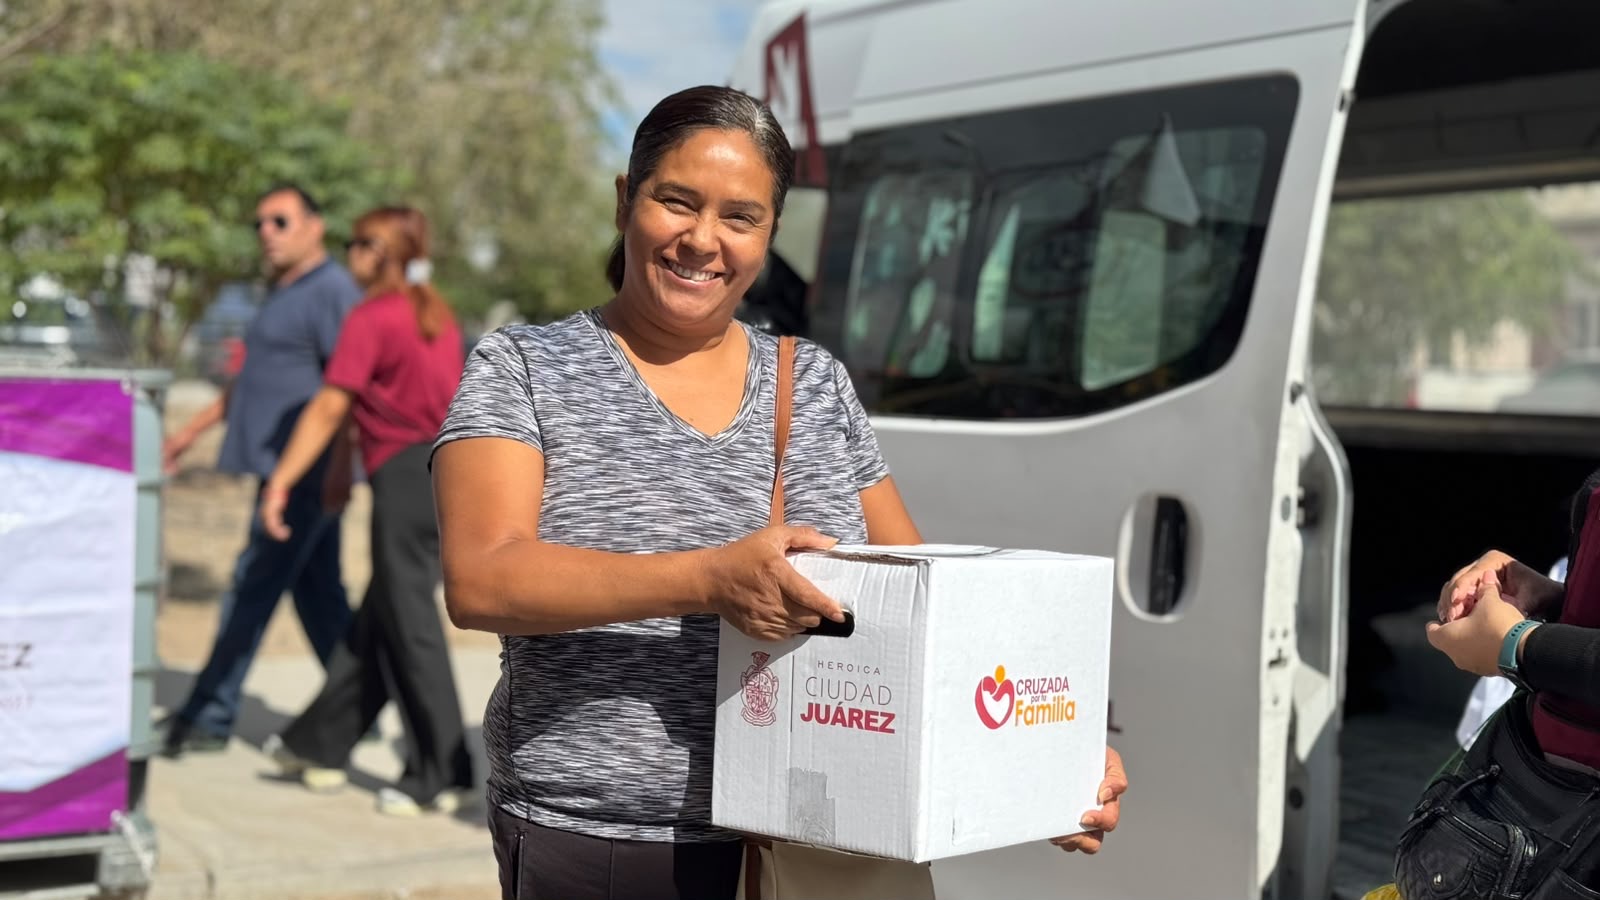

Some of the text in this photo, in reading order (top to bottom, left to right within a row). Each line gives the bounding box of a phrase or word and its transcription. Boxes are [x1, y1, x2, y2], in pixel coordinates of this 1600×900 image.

[817, 660, 881, 675] HEROICA
[805, 676, 892, 706] CIUDAD
[1016, 676, 1069, 696] CRUZADA
[1030, 693, 1047, 704] por tu
[800, 701, 896, 734] JUÁREZ
[1015, 695, 1075, 727] Familia
